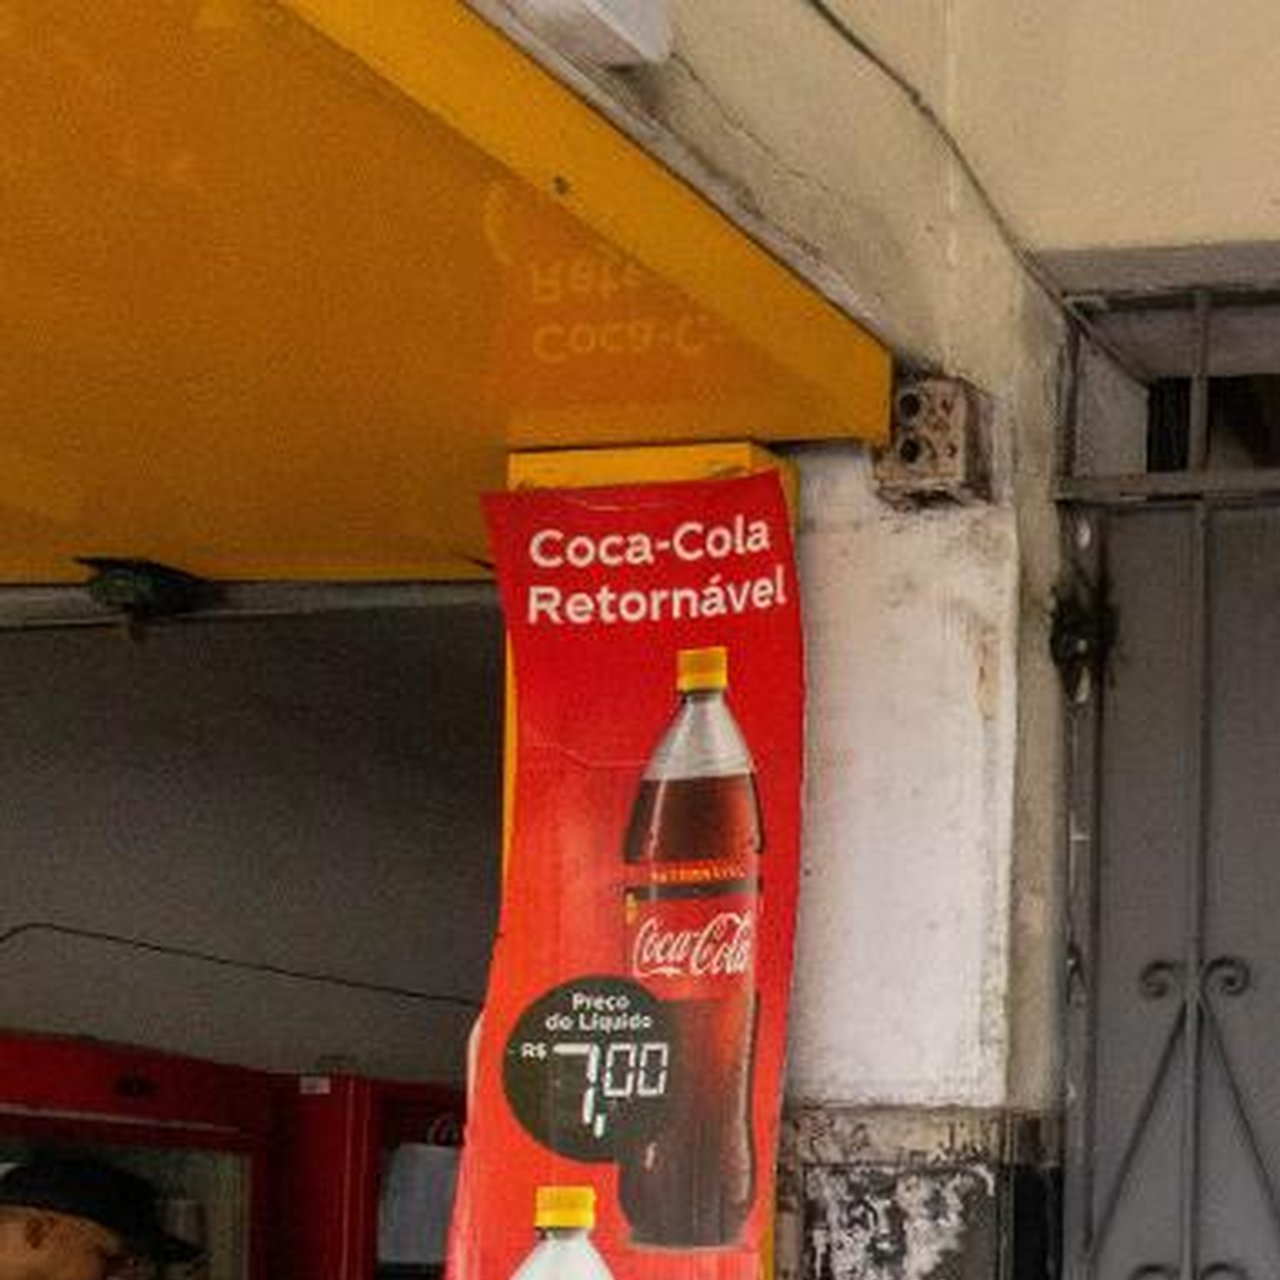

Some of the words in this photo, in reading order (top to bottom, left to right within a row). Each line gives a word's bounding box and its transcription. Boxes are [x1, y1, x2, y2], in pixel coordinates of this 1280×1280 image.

[529, 515, 770, 568] Coca-Cola
[528, 565, 788, 624] Retornável
[632, 911, 752, 978] Coca-Cola
[545, 1012, 574, 1031] do
[571, 992, 631, 1013] Preço
[521, 1042, 547, 1060] R$
[553, 1042, 668, 1138] 7,00
